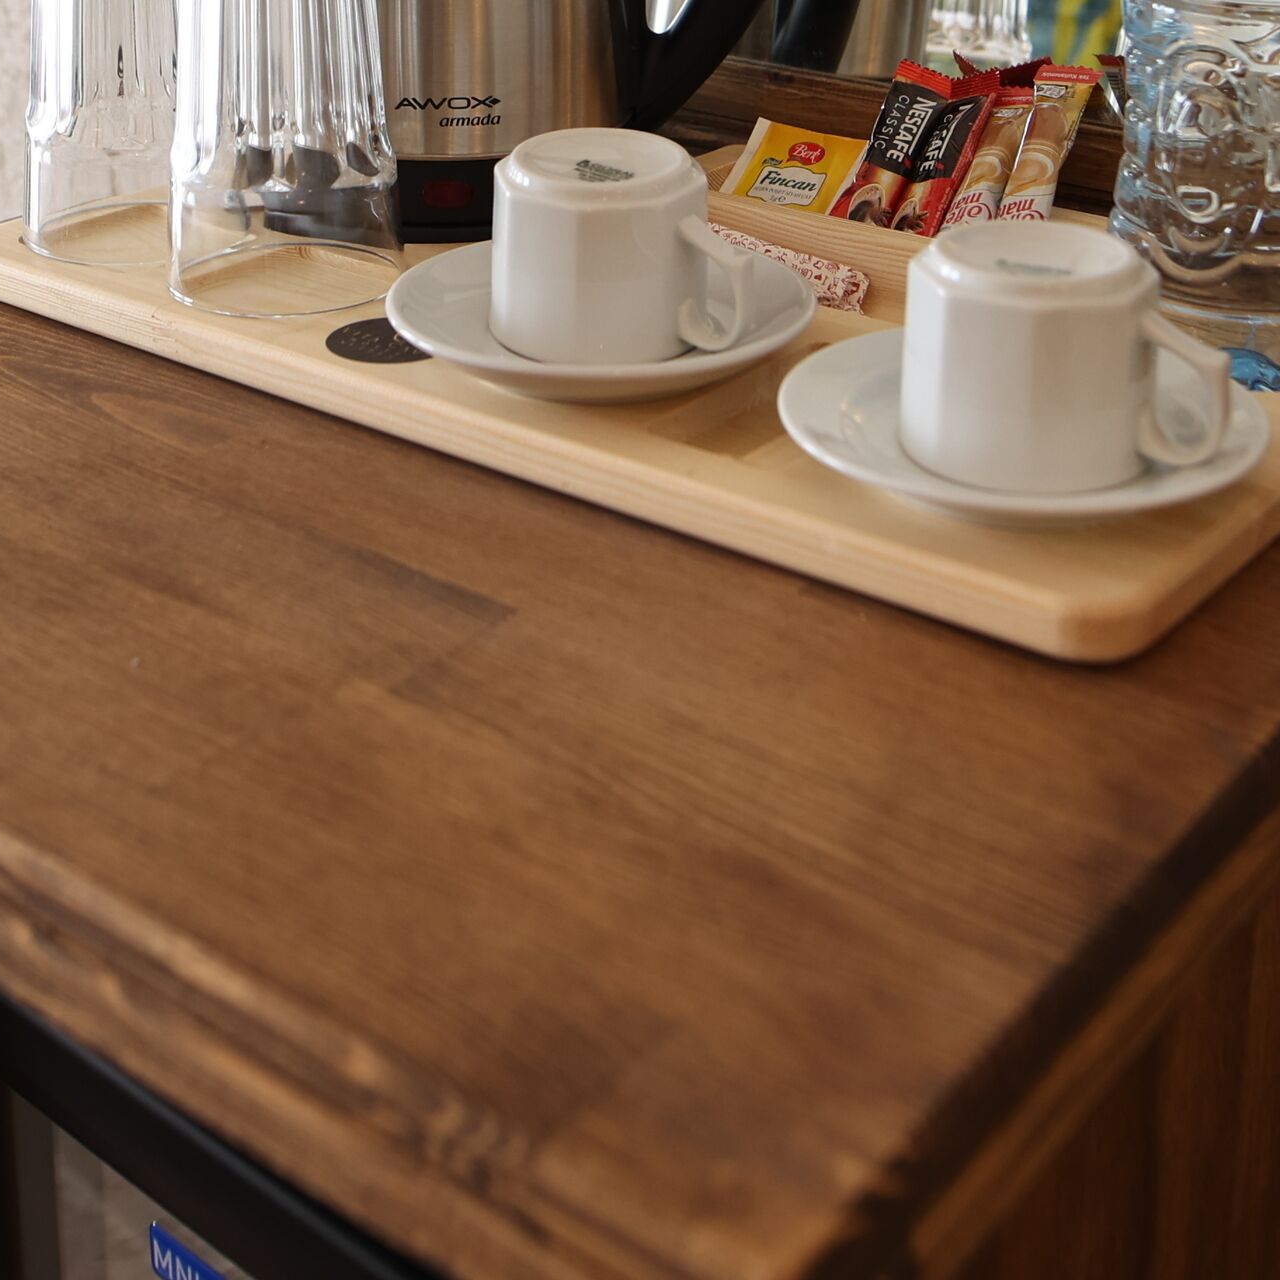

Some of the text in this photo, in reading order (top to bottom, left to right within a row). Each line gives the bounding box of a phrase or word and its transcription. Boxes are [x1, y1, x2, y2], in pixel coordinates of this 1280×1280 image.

[395, 96, 493, 110] AWOX
[439, 114, 501, 127] armada
[874, 95, 910, 150] CLASSIC
[760, 170, 817, 192] Fincan
[153, 1238, 200, 1280] MN
